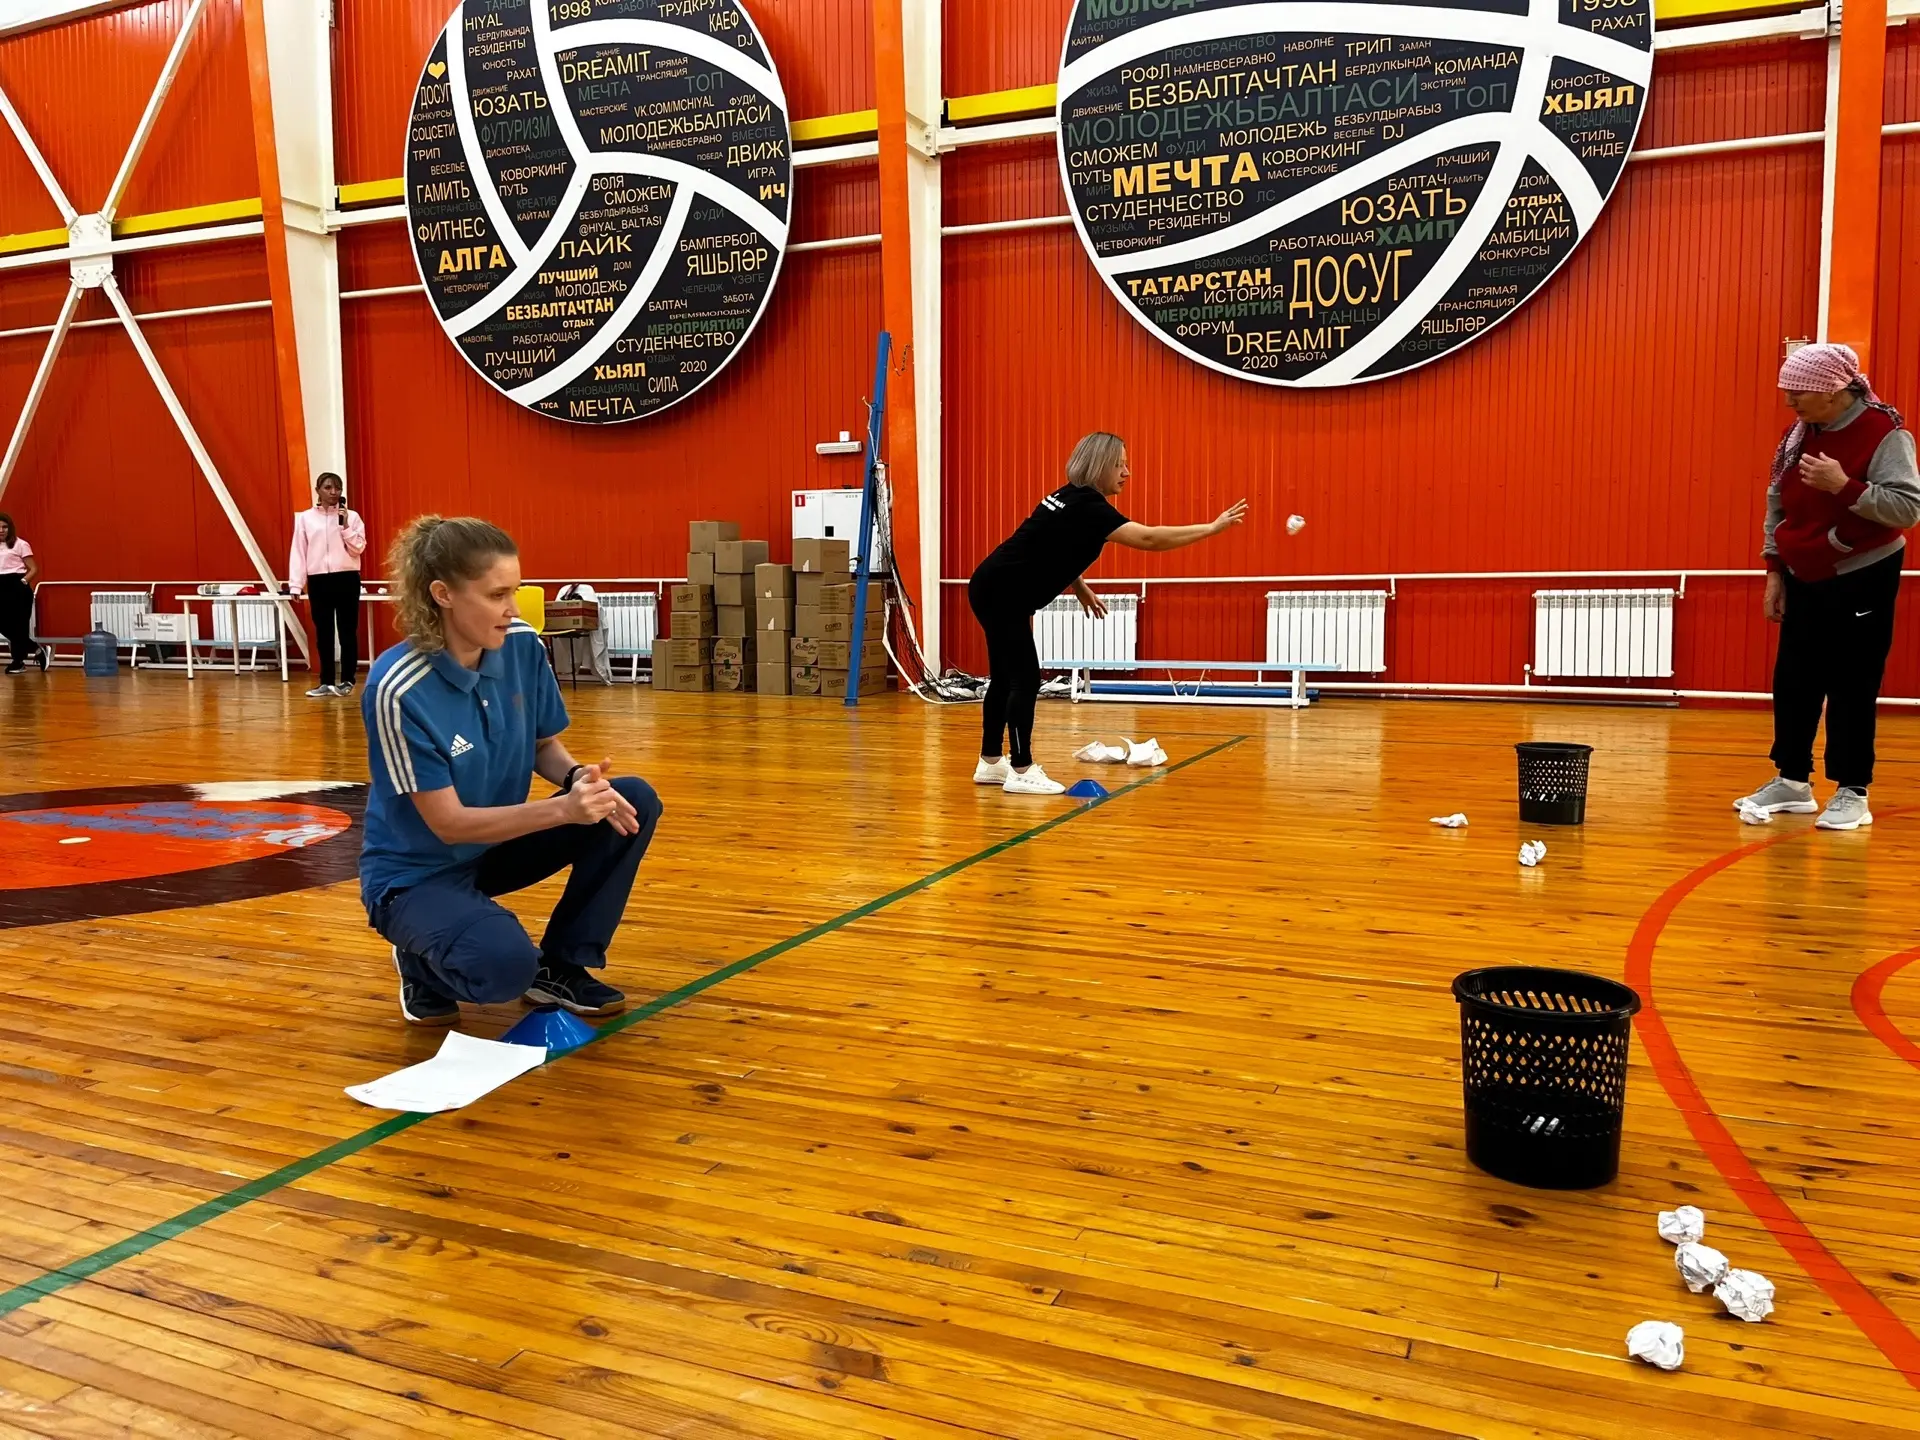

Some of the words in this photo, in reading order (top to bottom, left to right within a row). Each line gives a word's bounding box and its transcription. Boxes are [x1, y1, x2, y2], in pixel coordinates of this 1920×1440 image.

[550, 0, 592, 21] 1998
[617, 0, 657, 14] ЗАБОТА
[465, 13, 503, 31] HIYAL
[709, 9, 739, 33] КАЕФ
[1080, 16, 1137, 34] НАСПОРТЕ
[1591, 13, 1646, 32] РАХАТ
[477, 26, 530, 42] БЕРДУЛКЫНДА
[737, 33, 753, 47] DJ
[1071, 35, 1104, 46] КАЙТАМ
[468, 39, 526, 57] РЕЗИДЕНТЫ
[595, 48, 620, 58] ЗНАНИЕ
[1165, 35, 1276, 61] ПРОСТРАНСТВО
[1283, 36, 1334, 53] НАВОЛНЕ
[1345, 37, 1391, 57] ТРИП
[1399, 40, 1432, 52] ЗАМАН
[482, 58, 517, 70] ЮНОСТЬ
[558, 50, 578, 62] МИР
[655, 56, 688, 69] ПРЯМАЯ
[1173, 52, 1276, 76] НАМНЕВСЕРАВНО
[1434, 50, 1519, 76] КОМАНДА
[506, 67, 537, 81] РАХАТ
[562, 50, 651, 84] DREAMIT
[1121, 63, 1170, 85] РОФЛ
[1345, 55, 1431, 77] БЕРДУЛКЫНДА
[636, 68, 688, 82] ТРАНСЛЯЦИЯ
[684, 71, 724, 94] ТОП
[1551, 74, 1610, 90] ЮНОСТЬ
[472, 84, 508, 97] ДВИЖЕНИЕ
[578, 80, 631, 102] МЕЧТА
[1086, 84, 1118, 98] ЖИЗА
[1129, 59, 1337, 110] БЕЗБАЛТАЧТАН
[1420, 77, 1466, 91] ЭКСТРИМ
[473, 90, 547, 118] ЮЗАТЬ
[729, 94, 756, 107] ФУДИ
[1449, 82, 1507, 110] ТОП
[1543, 85, 1634, 115] ХЫЯЛ
[412, 109, 452, 122] КОНКУРСЫ
[579, 103, 628, 117] МАСТЕРСКИЕ
[1068, 73, 1417, 147] МОЛОДЕЖЬБАЛТАСИ
[1072, 102, 1123, 118] ДВИЖЕНИЕ
[1334, 103, 1442, 126] БЕЗБУЛДЫРАБЫЗ
[600, 104, 771, 145] МОЛОДЕЖЬБАЛТАСИ
[1554, 108, 1632, 131] РЕНОВАЦИЯМЦ
[412, 123, 456, 143] СОЦСЕТИ
[481, 115, 550, 144] ФУТУРИЗМ
[732, 126, 776, 142] ВМЕСТЕ
[1219, 120, 1327, 148] МОЛОДЕЖЬ
[1334, 127, 1375, 140] ВЕСЕЛЬЕ
[1382, 123, 1404, 140] DJ
[1570, 129, 1615, 143] СТИЛЬ
[647, 133, 723, 152] НАМНЕВСЕРАВНО
[1165, 139, 1206, 156] ФУДИ
[1582, 142, 1624, 158] ИНДЕ
[413, 147, 441, 162] ТРИП
[486, 144, 530, 159] ДИСКОТЕКА
[525, 148, 567, 160] НАСПОРТЕ
[697, 151, 724, 161] ПОБЕДА
[727, 140, 784, 168] ДВИЖ
[1070, 141, 1158, 168] СМОЖЕМ
[1262, 140, 1366, 166] КОВОРКИНГ
[1436, 150, 1490, 167] ЛУЧШИЙ
[430, 162, 465, 176] ВЕСЕЛЬЕ
[501, 162, 568, 181] КОВОРКИНГ
[748, 166, 776, 179] ИГРА
[1072, 169, 1112, 186] ПУТЬ
[1113, 151, 1261, 198] МЕЧТА
[1267, 163, 1338, 179] МАСТЕРСКИЕ
[592, 175, 624, 191] ВОЛЯ
[1388, 173, 1447, 191] БАЛТАЧ
[1448, 174, 1483, 184] ГАМИТЬ
[1519, 175, 1549, 190] ДОМ
[416, 180, 470, 204] ГАМИТЬ
[500, 183, 528, 197] ПУТЬ
[604, 184, 671, 206] СМОЖЕМ
[1086, 184, 1111, 197] МИР
[1256, 190, 1276, 203] ЛС
[412, 200, 482, 217] ПРОСТРАНСТВО
[517, 196, 557, 209] КРЕАТИВ
[1086, 188, 1244, 222] СТУДЕНЧЕСТВО
[1341, 188, 1467, 225] ЮЗАТЬ
[517, 210, 550, 222] КАЙТАМ
[580, 204, 649, 220] БЕЗБУЛДЫРАБЫЗ
[693, 208, 724, 221] ФУДИ
[1505, 206, 1570, 228] HIYAL
[579, 216, 662, 236] @HIYAL_BALTASI
[1091, 221, 1135, 235] МУЗЫКА
[1148, 211, 1231, 231] РЕЗИДЕНТЫ
[417, 217, 486, 243] ФИТНЕС
[1375, 217, 1455, 246] ХАЙП
[1488, 225, 1570, 245] АМБИЦИИ
[558, 233, 632, 260] ЛАЙК
[680, 231, 758, 252] БАМПЕРБОЛ
[1096, 234, 1166, 251] НЕТВОРКИНГ
[1269, 230, 1374, 251] РАБОТАЮЩАЯ
[438, 244, 507, 274] АЛГА
[1194, 253, 1282, 270] ВОЗМОЖНОСТЬ
[1479, 245, 1550, 261] КОНКУРСЫ
[613, 261, 631, 272] ДОМ
[687, 248, 768, 277] ЯШЬЛӘР
[1483, 263, 1548, 278] ЧЕЛЕНДЖ
[538, 265, 599, 285] ЛУЧШИЙ
[1127, 267, 1271, 297] ТАТАРСТАН
[444, 282, 490, 294] НЕТВОРКИНГ
[555, 280, 627, 297] МОЛОДЕЖЬ
[682, 283, 723, 294] ЧЕЛЕНДЖ
[1289, 249, 1413, 320] ДОСУГ
[1468, 285, 1518, 297] ПРЯМАЯ
[722, 293, 755, 303] ЗАБОТА
[1138, 294, 1184, 306] СТУДСИЛА
[1204, 284, 1283, 304] ИСТОРИЯ
[506, 297, 614, 320] БЕЗБАЛТАЧТАН
[648, 299, 688, 312] БАЛТАЧ
[1155, 300, 1283, 324] МЕРОПРИЯТИЯ
[1438, 298, 1516, 311] ТРАНСЛЯЦИЯ
[669, 308, 752, 320] ВРЕМЯМОЛОДЫХ
[1319, 308, 1381, 325] ТАНЦЫ
[647, 317, 744, 336] МЕРОПРИЯТИЯ
[1176, 320, 1234, 337] ФОРУМ
[1421, 317, 1486, 335] ЯШЬЛӘР
[462, 334, 493, 344] НАВОЛНЕ
[512, 330, 580, 345] РАБОТАЮЩАЯ
[616, 331, 735, 354] СТУДЕНЧЕСТВО
[1226, 325, 1351, 355] DREAMIT
[484, 345, 556, 367] ЛУЧШИЙ
[1242, 354, 1278, 370] 2020
[1284, 351, 1327, 362] ЗАБОТА
[494, 367, 533, 381] ФОРУМ
[594, 362, 646, 381] ХЫЯЛ
[680, 360, 707, 373] 2020
[647, 376, 679, 393] СИЛА
[569, 397, 636, 418] МЕЧТА
[640, 398, 660, 406] ЦЕНТР
